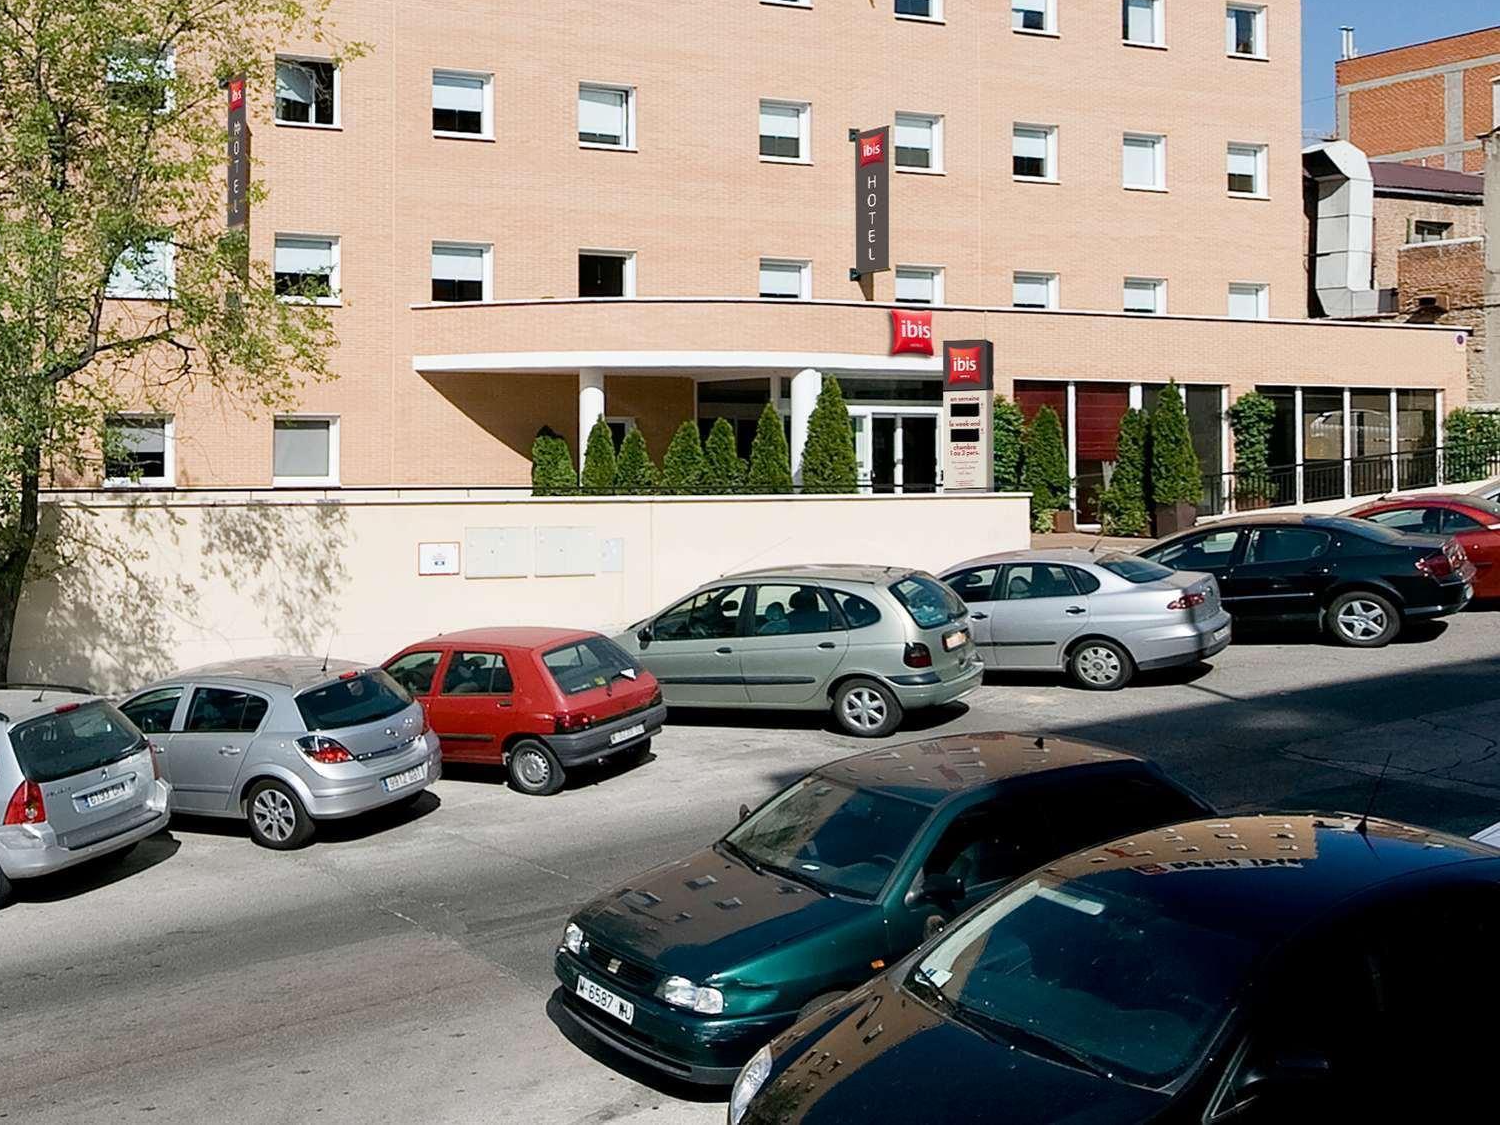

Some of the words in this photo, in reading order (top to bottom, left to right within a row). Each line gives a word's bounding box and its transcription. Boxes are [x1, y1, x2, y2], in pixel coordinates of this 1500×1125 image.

[862, 142, 881, 157] ibis
[866, 175, 877, 261] HOTEL
[900, 319, 931, 339] ibis
[953, 356, 977, 372] ibis
